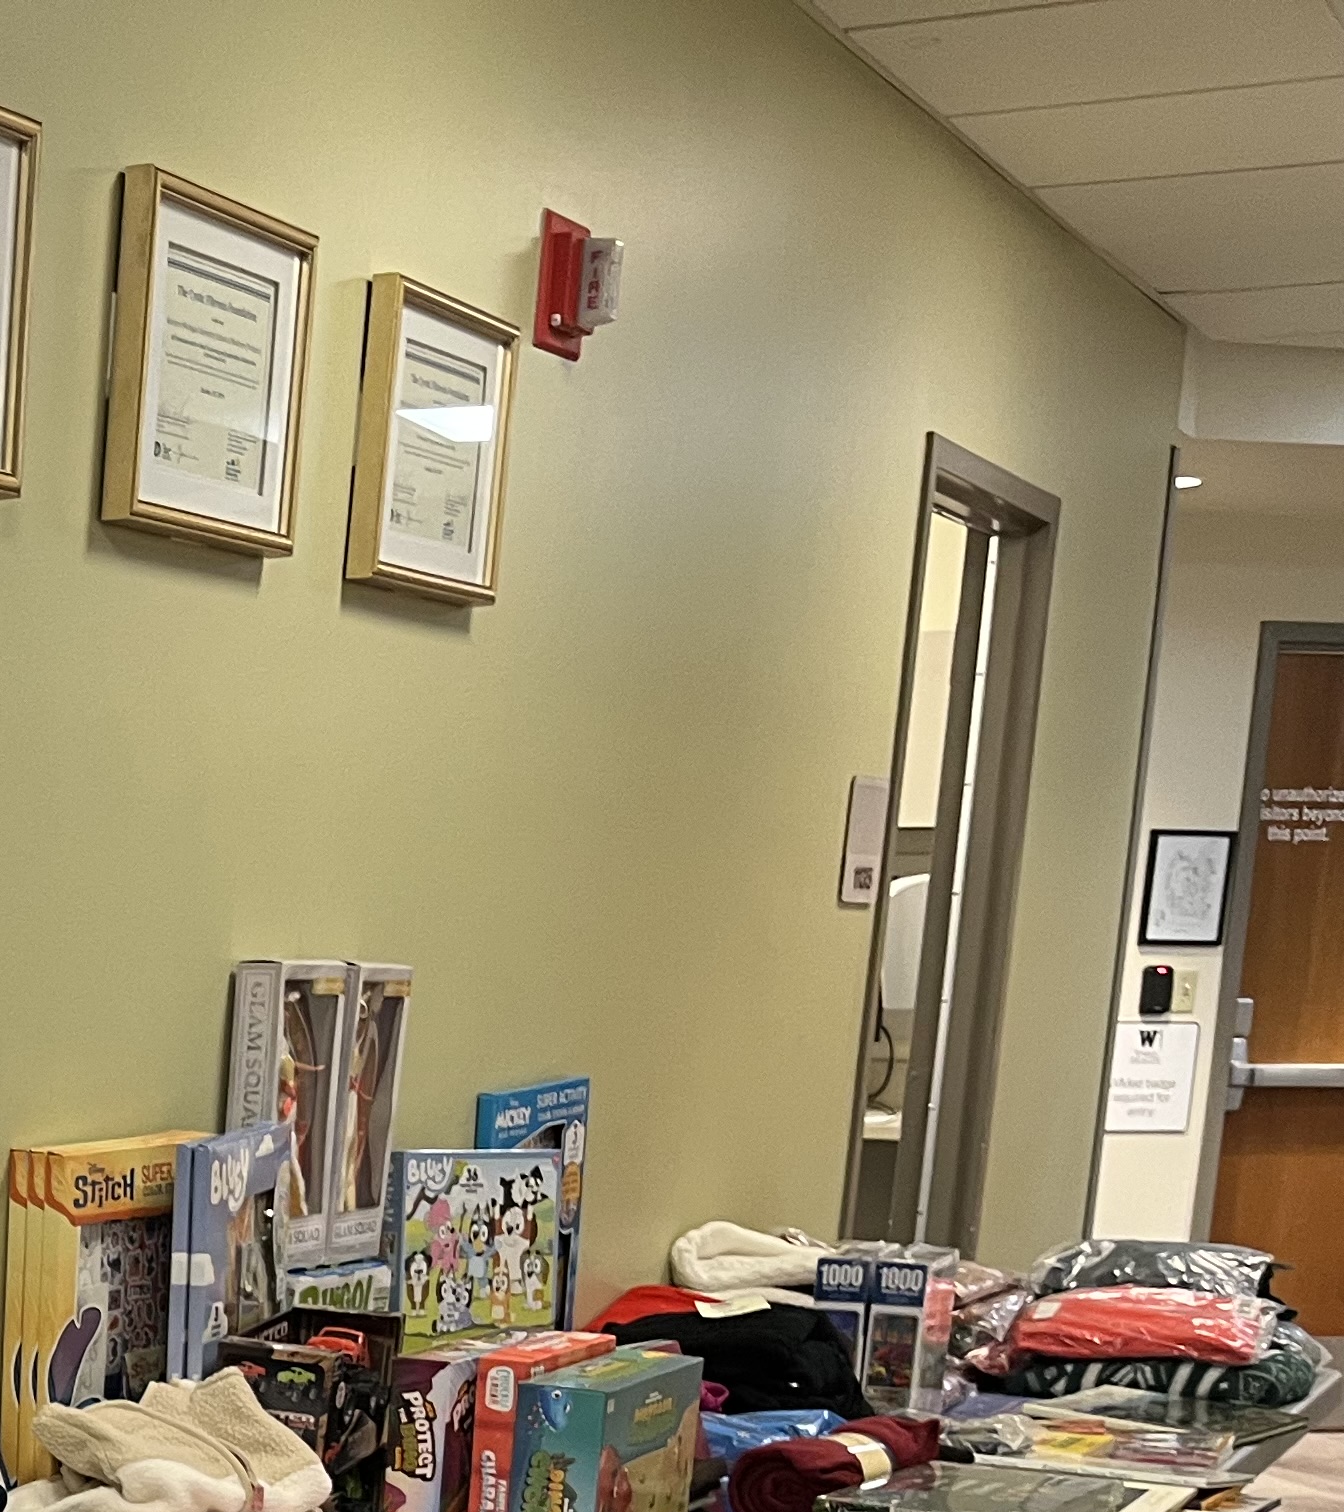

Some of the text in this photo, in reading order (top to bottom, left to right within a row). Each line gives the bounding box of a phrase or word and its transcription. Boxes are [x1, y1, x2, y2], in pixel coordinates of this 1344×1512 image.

[820, 1263, 863, 1286] 1000
[880, 1266, 924, 1291] 1000
[401, 1391, 435, 1481] PROTECT
